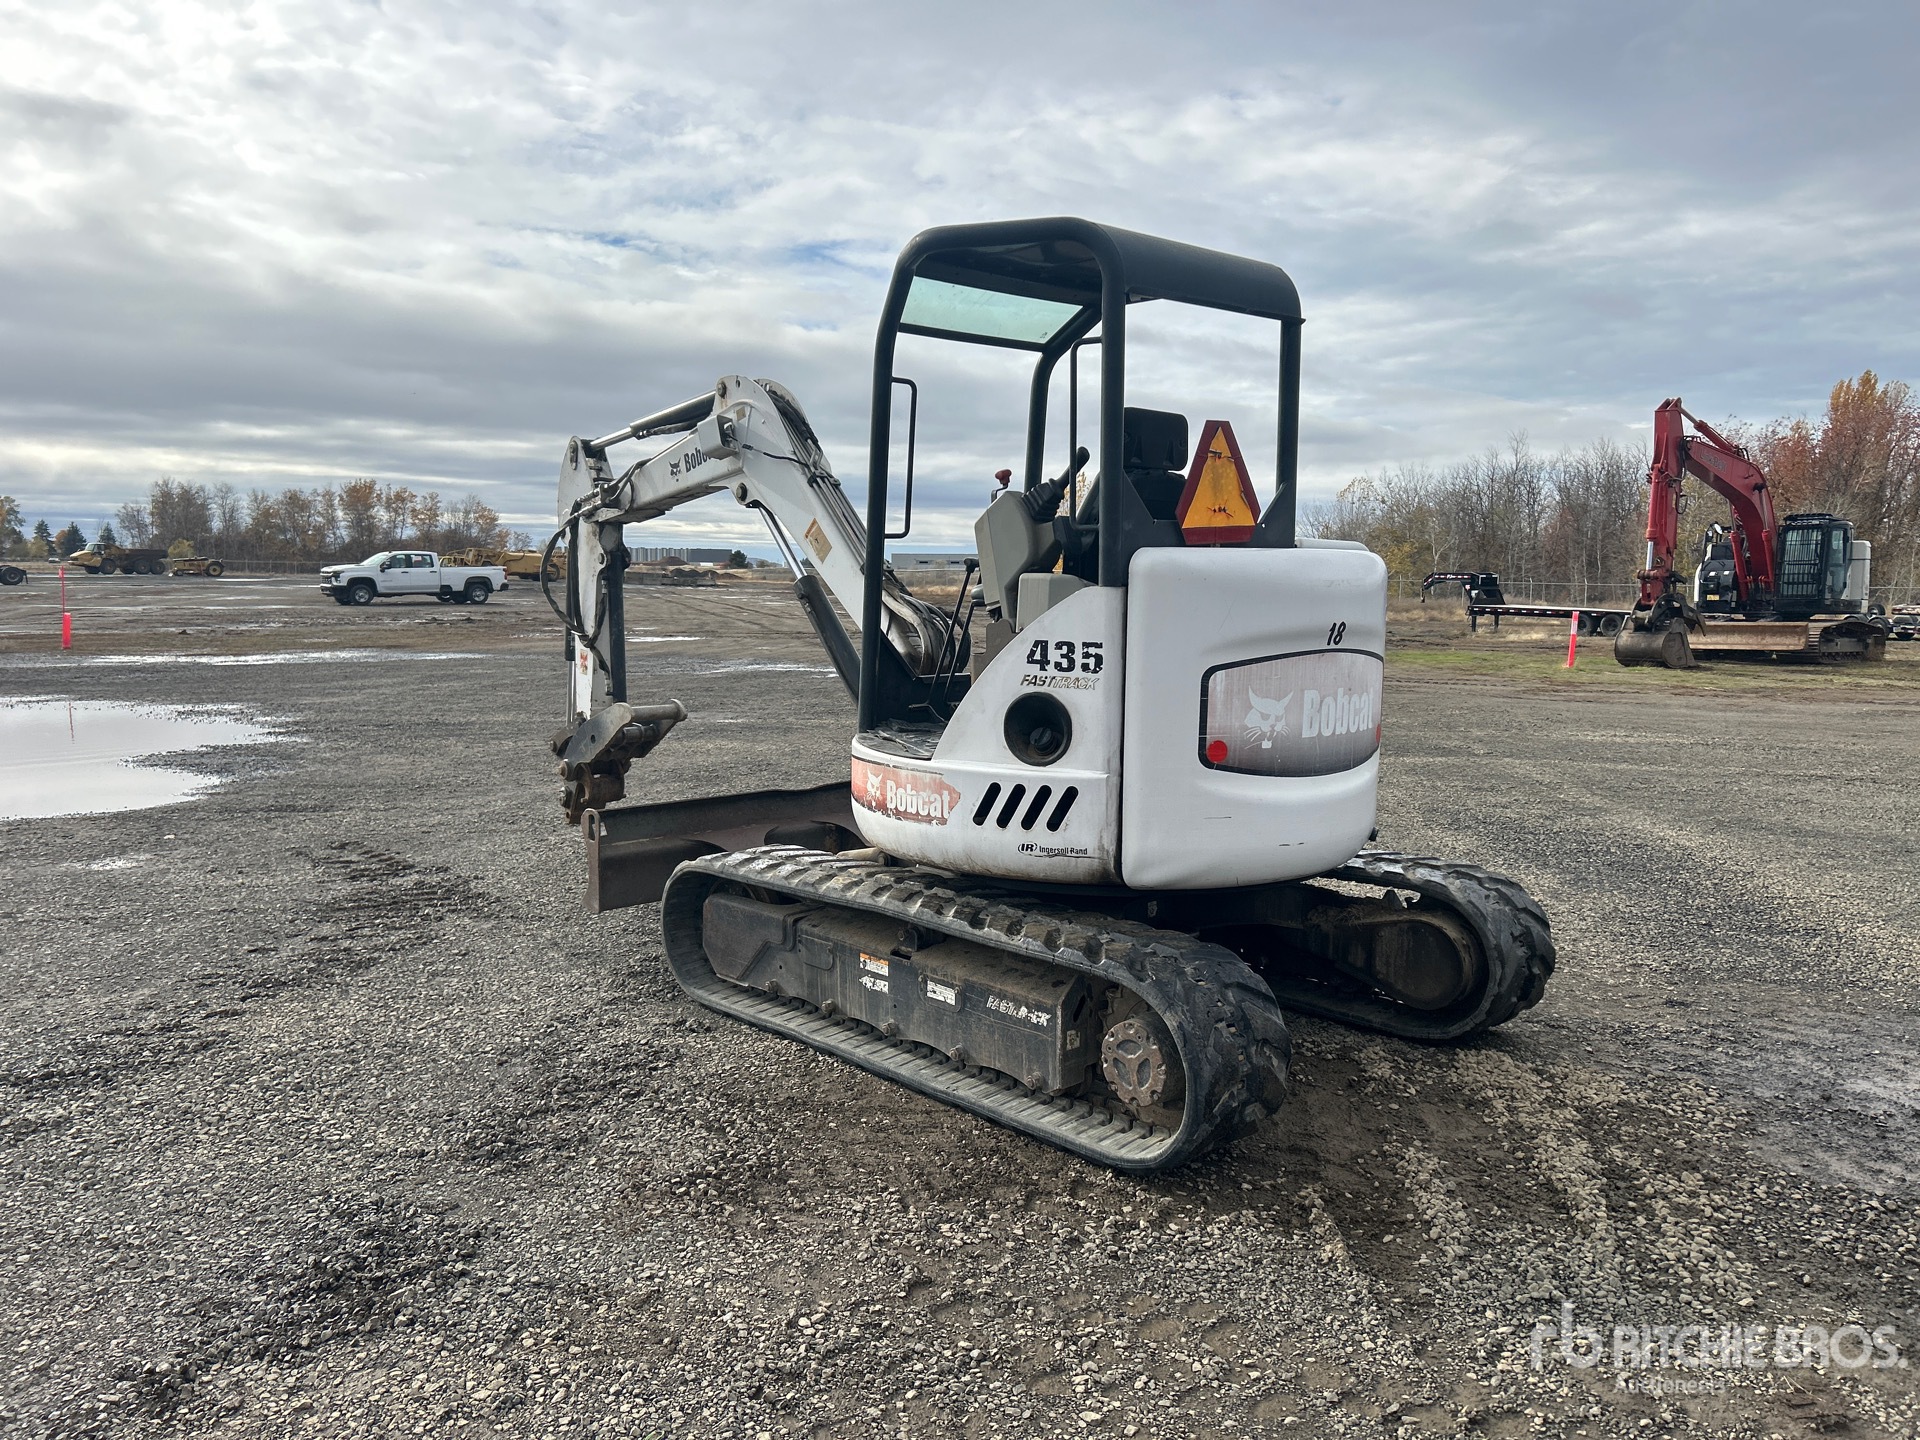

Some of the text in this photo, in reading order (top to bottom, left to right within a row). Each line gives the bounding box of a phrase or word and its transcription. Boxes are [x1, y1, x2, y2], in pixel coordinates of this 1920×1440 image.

[1326, 621, 1346, 646] 18
[1026, 639, 1104, 674] 435
[1302, 687, 1375, 738] Bobcat
[886, 779, 950, 819] Bobcat
